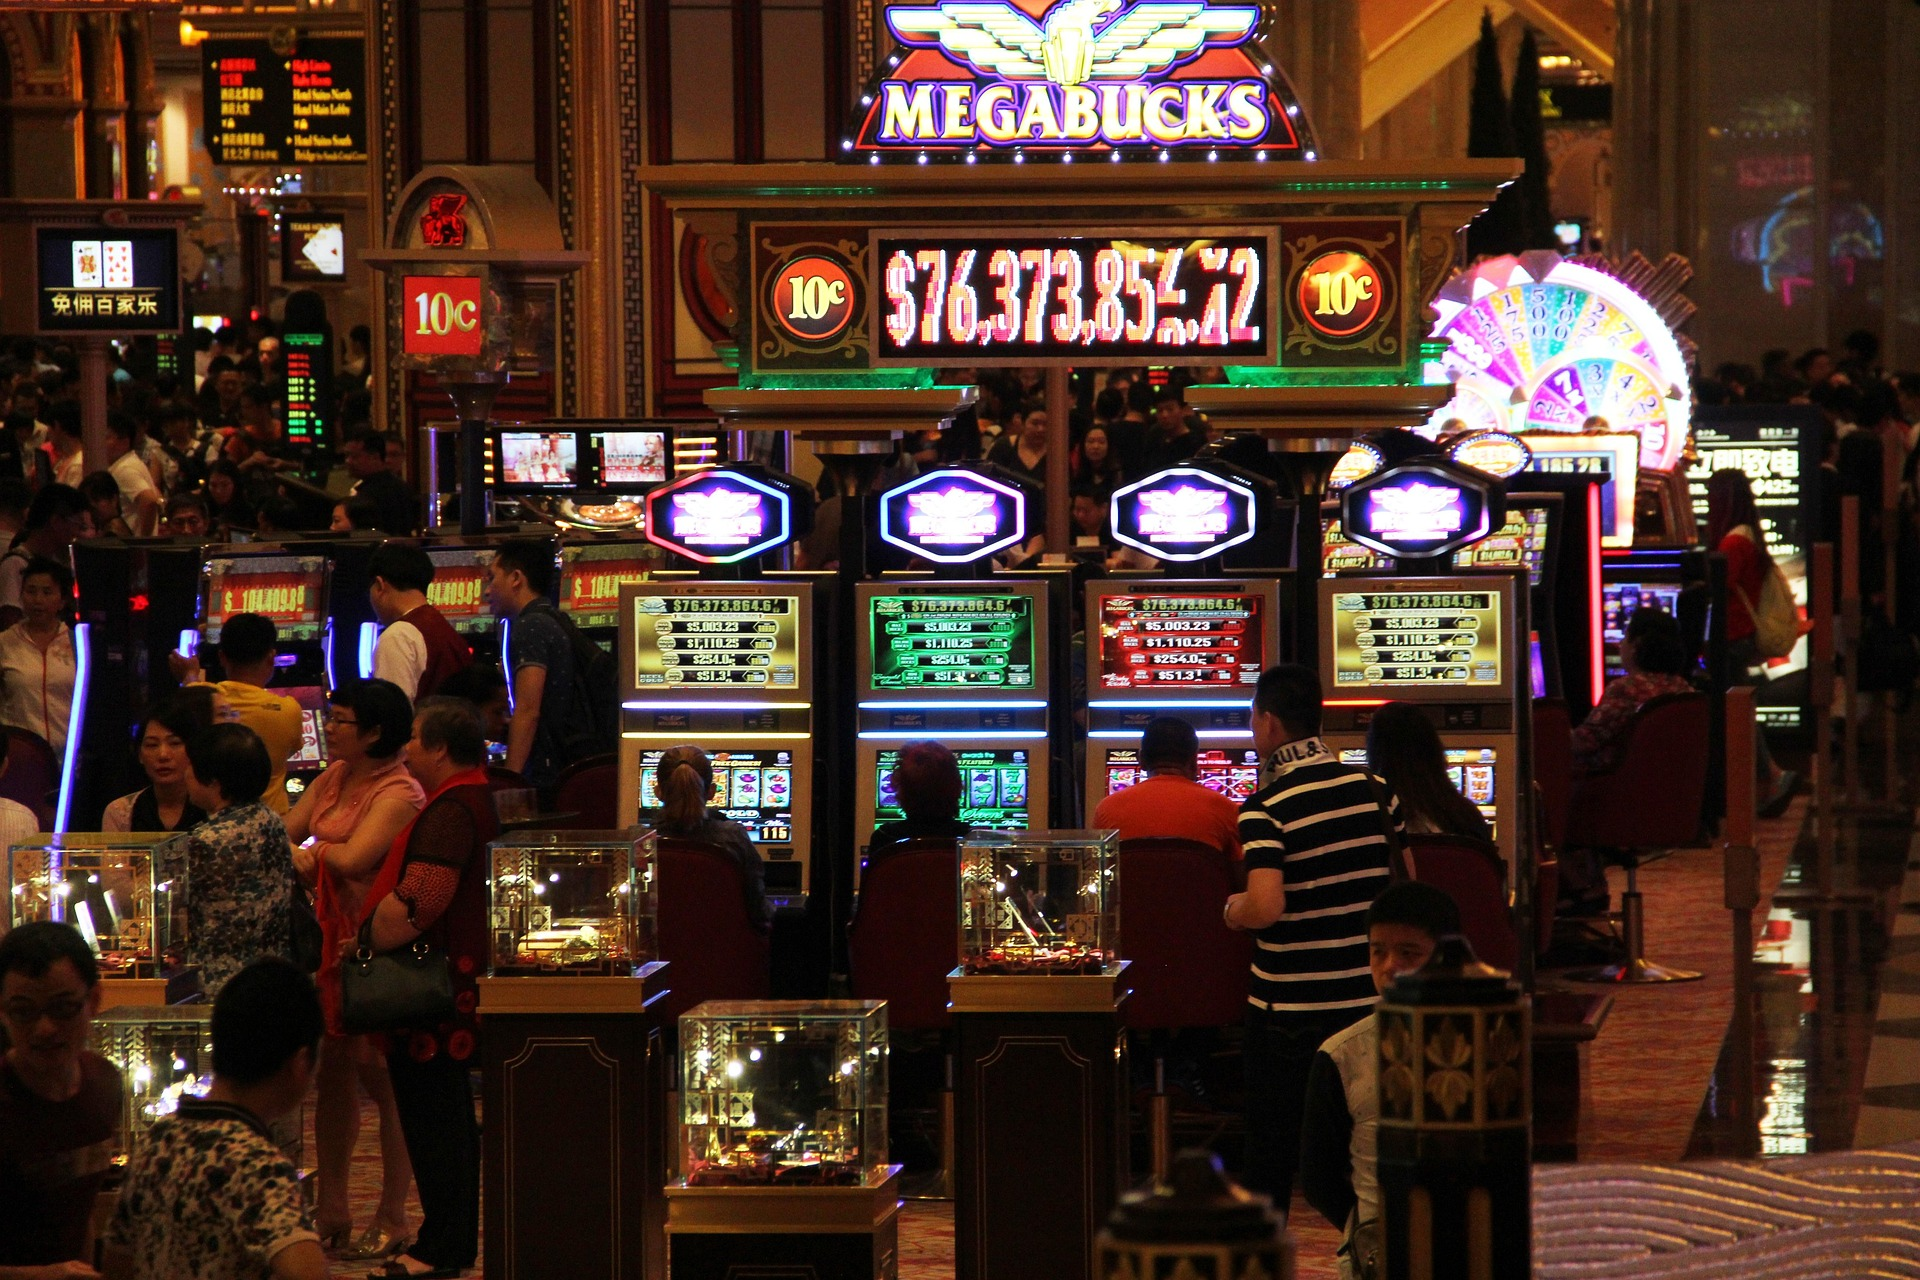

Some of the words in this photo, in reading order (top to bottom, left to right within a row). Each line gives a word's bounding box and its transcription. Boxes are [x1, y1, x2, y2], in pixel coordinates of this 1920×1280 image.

[880, 83, 1266, 141] MEGABUCKS
[51, 293, 158, 316] 免佣百家乐
[1531, 288, 1547, 337] 500
[1554, 290, 1575, 340] 100
[687, 622, 739, 632] $5,003.23
[1145, 621, 1211, 631] $5,003.23
[1386, 618, 1439, 628] $5,003.23
[687, 638, 740, 649] $1,110.25
[925, 639, 973, 649] $1,110.25
[1146, 638, 1212, 648] $1,110.25
[1386, 634, 1440, 645] $1,110.25
[763, 827, 788, 840] 115
